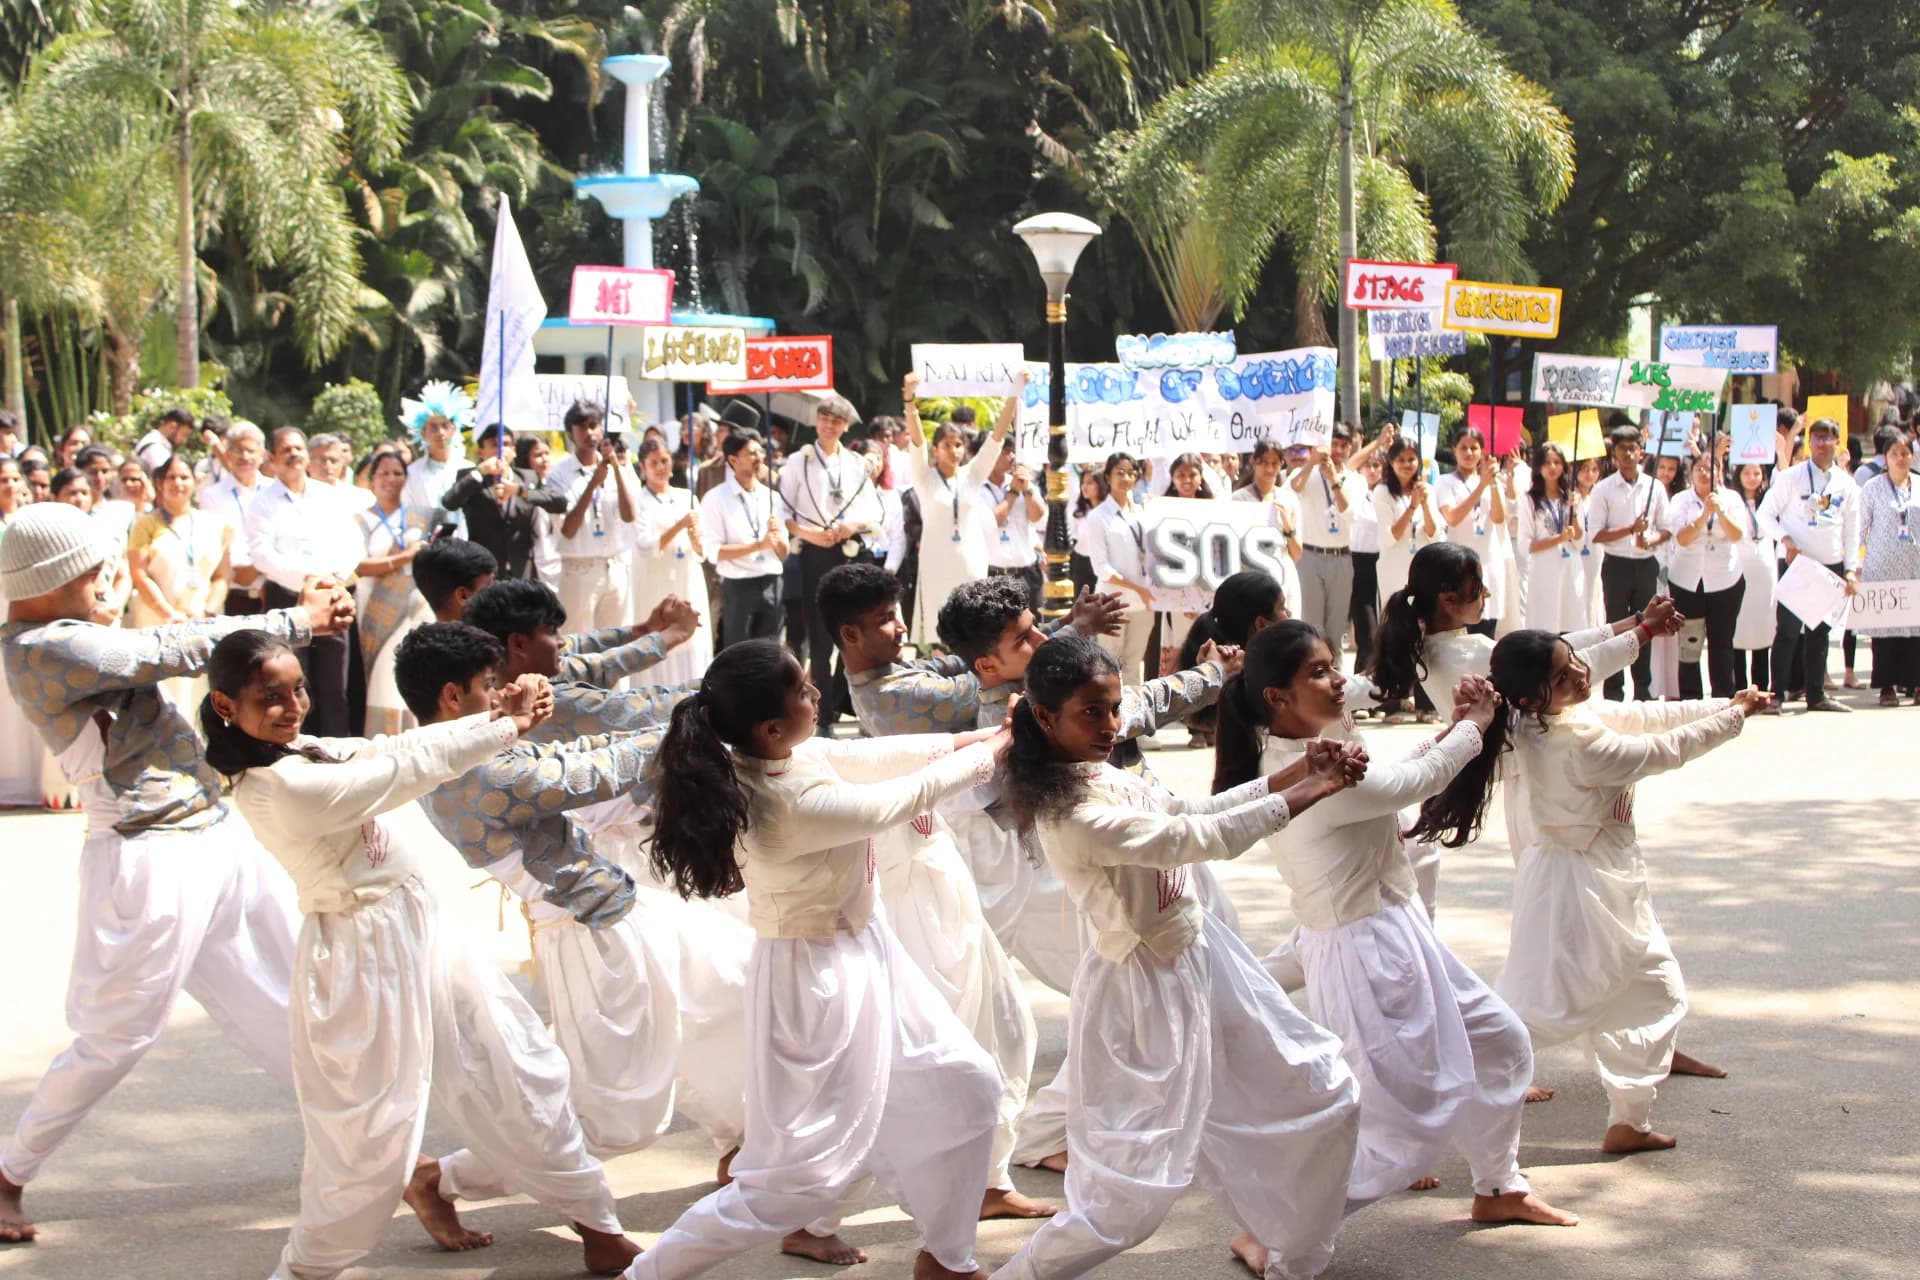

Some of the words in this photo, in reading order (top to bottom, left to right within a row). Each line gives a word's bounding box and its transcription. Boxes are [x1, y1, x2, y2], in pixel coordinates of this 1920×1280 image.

[1354, 273, 1424, 302] STAGE
[1161, 368, 1203, 403] OF
[1148, 517, 1284, 592] SOS
